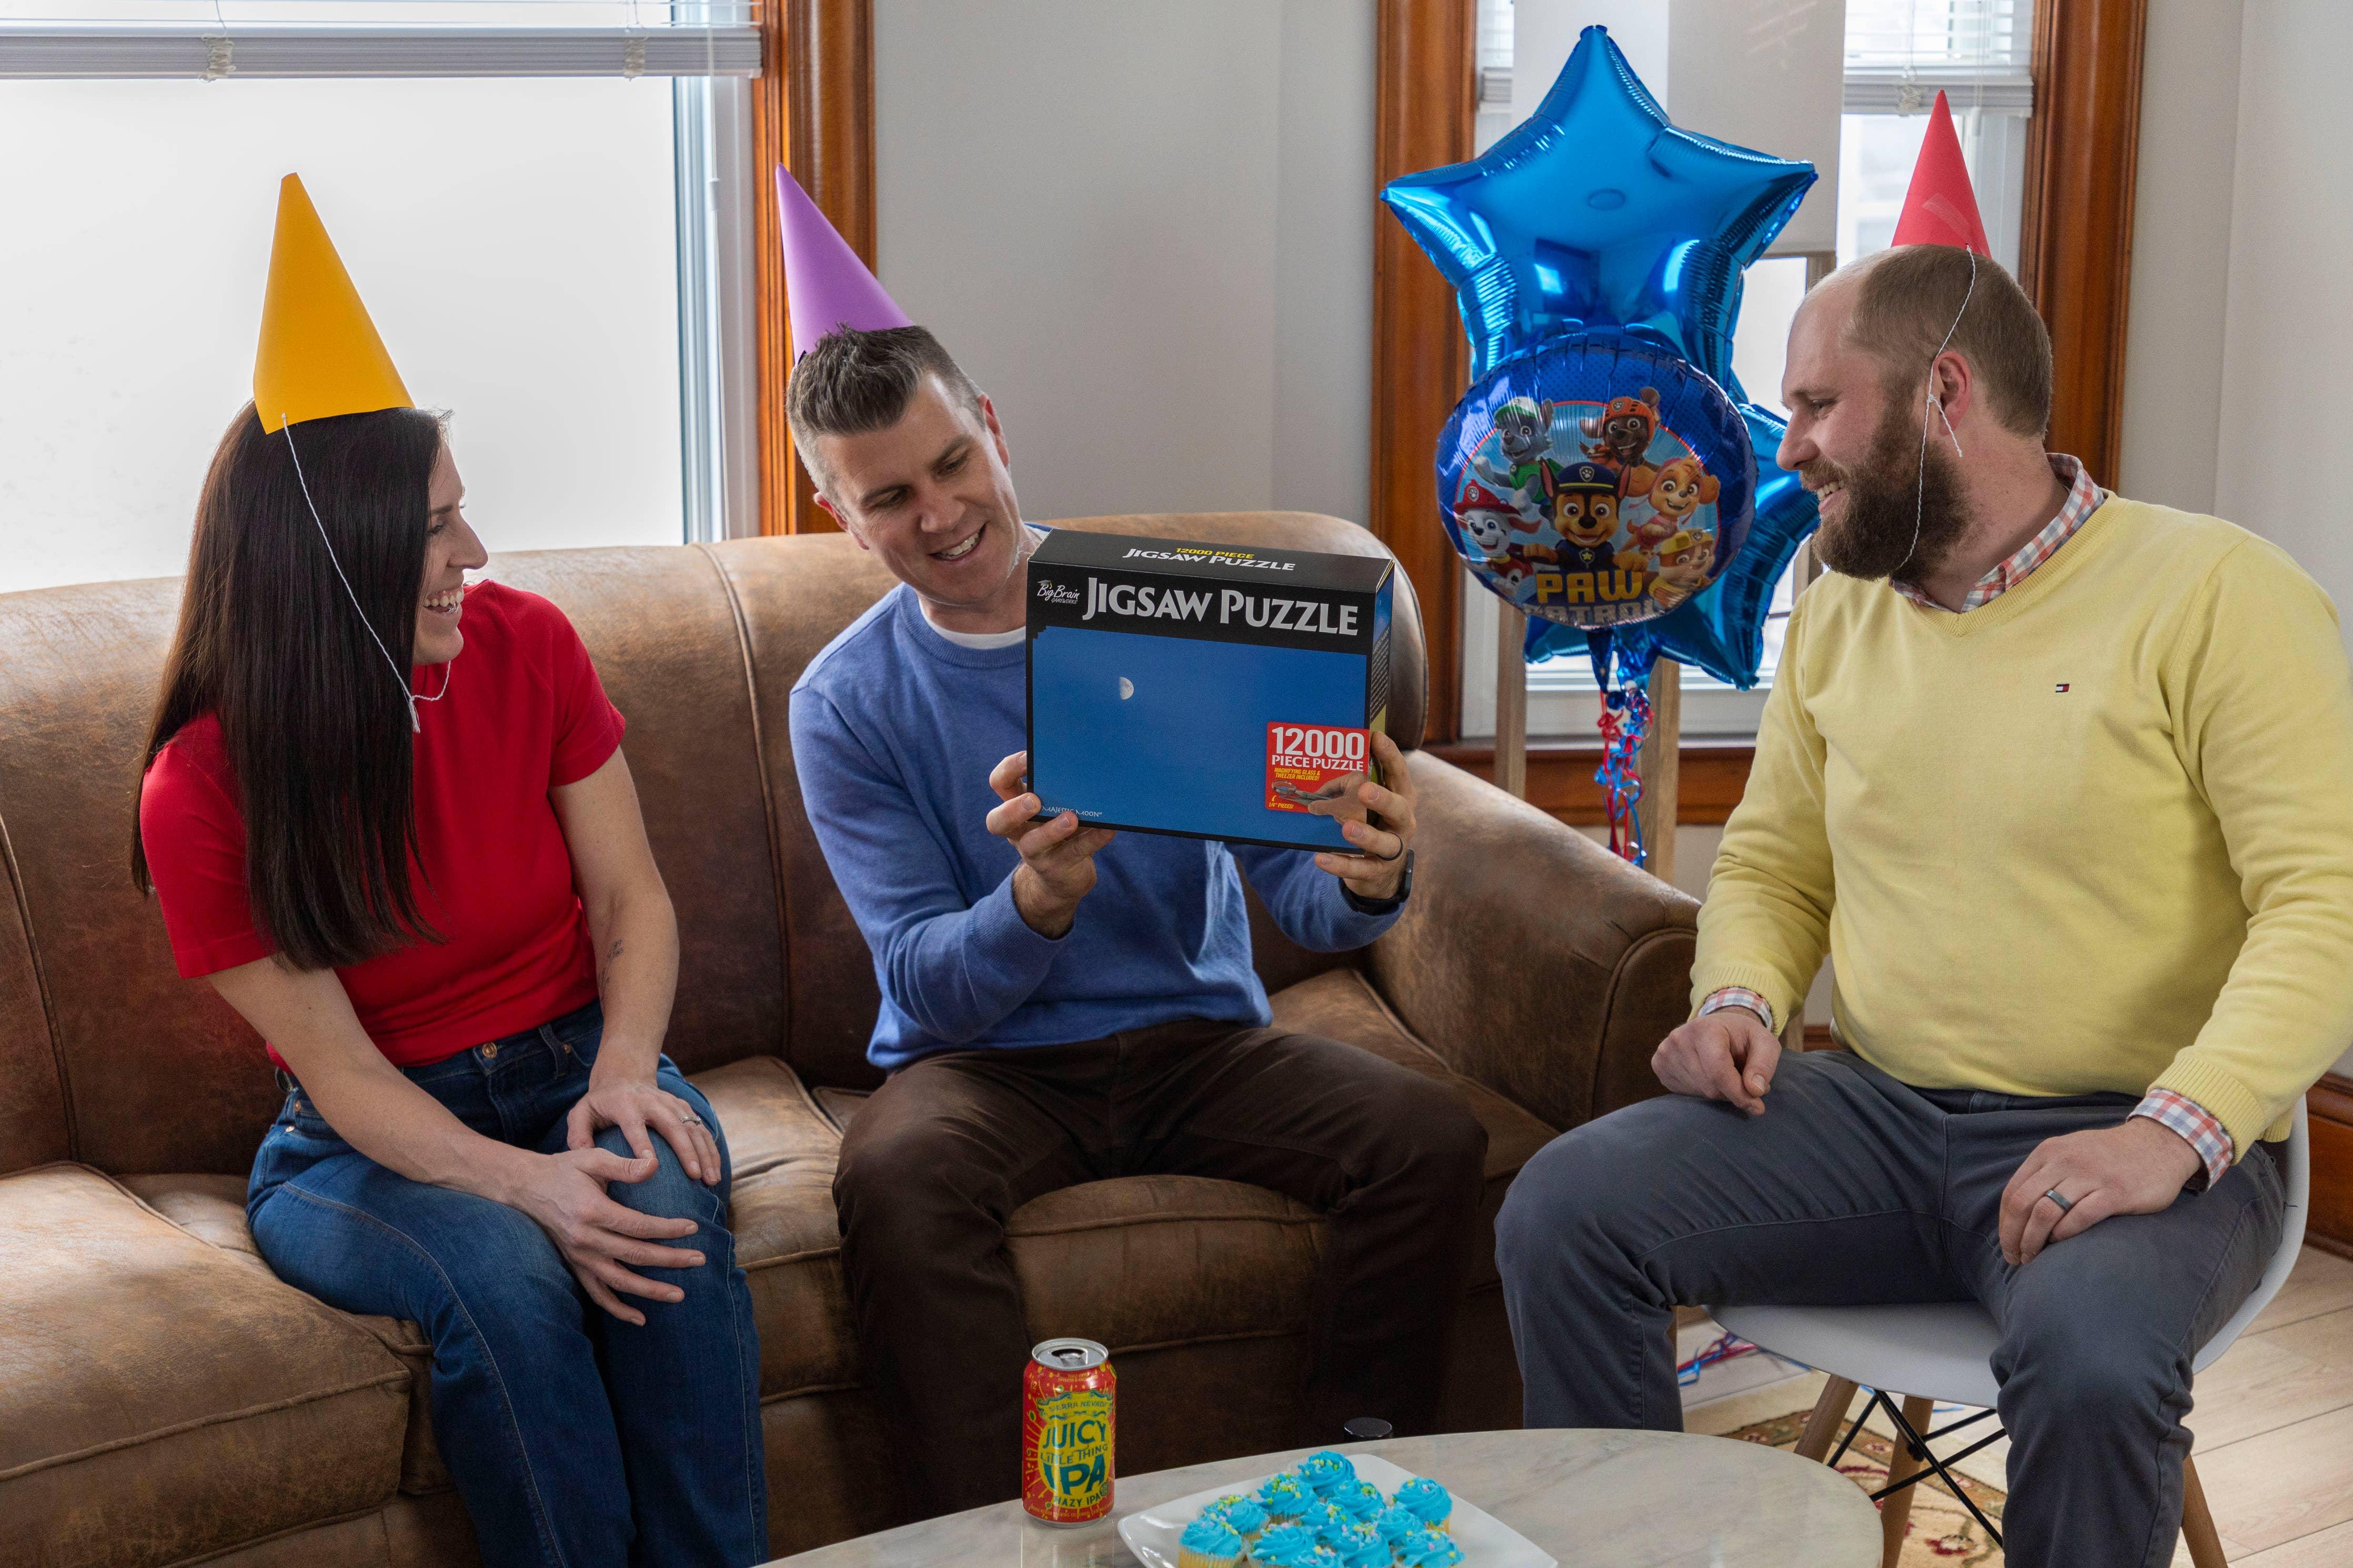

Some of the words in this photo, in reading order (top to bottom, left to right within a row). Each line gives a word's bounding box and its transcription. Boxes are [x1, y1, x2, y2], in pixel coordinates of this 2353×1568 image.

[1122, 548, 1206, 562] JIGSAW
[1209, 555, 1296, 571] PUZZLE
[1215, 551, 1255, 559] PIECE
[1037, 584, 1054, 601] Big
[1053, 585, 1080, 600] Brain
[1536, 570, 1643, 604] PAW
[1082, 577, 1213, 622] JIGSAW
[1220, 589, 1359, 636] PUZZLE
[1272, 726, 1364, 760] 12000
[1271, 755, 1310, 768] PIECE
[1313, 758, 1364, 772] PUZZLE
[1042, 1420, 1106, 1450] JUICY
[1040, 1451, 1074, 1465] LITTLE
[1072, 1444, 1108, 1461] THING
[1043, 1453, 1105, 1495] IPA
[1054, 1497, 1082, 1508] HAZY
[1087, 1493, 1101, 1505] IPA
